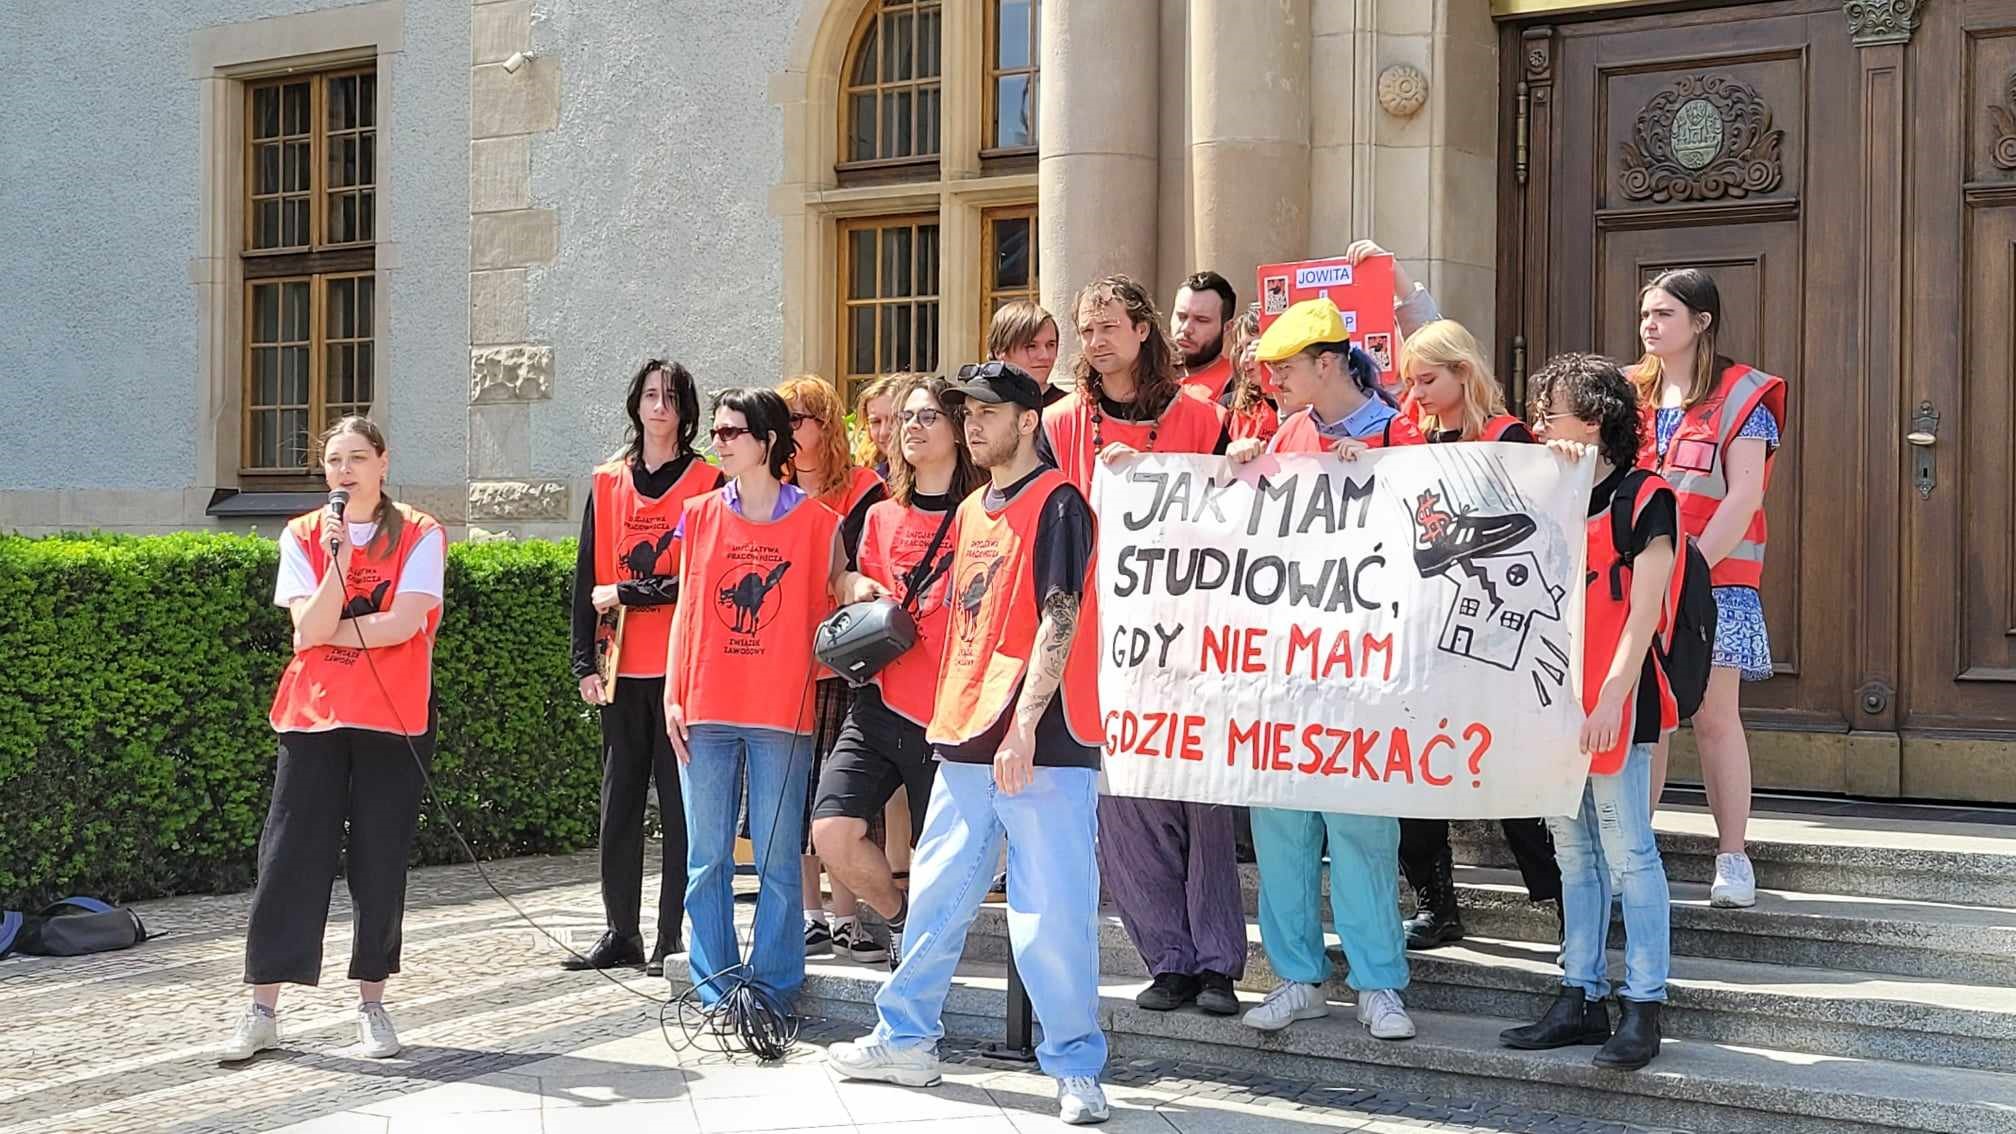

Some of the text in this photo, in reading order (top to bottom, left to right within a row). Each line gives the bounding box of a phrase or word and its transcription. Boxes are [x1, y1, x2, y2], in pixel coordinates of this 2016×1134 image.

[1298, 267, 1350, 284] JOWITA
[1123, 472, 1375, 537] JAK MAM
[1113, 542, 1399, 618] STUDIOWAĆ,
[1112, 622, 1394, 681] GDY NIE MAM
[1104, 711, 1492, 788] GDZIE MIESZKAĆ?
